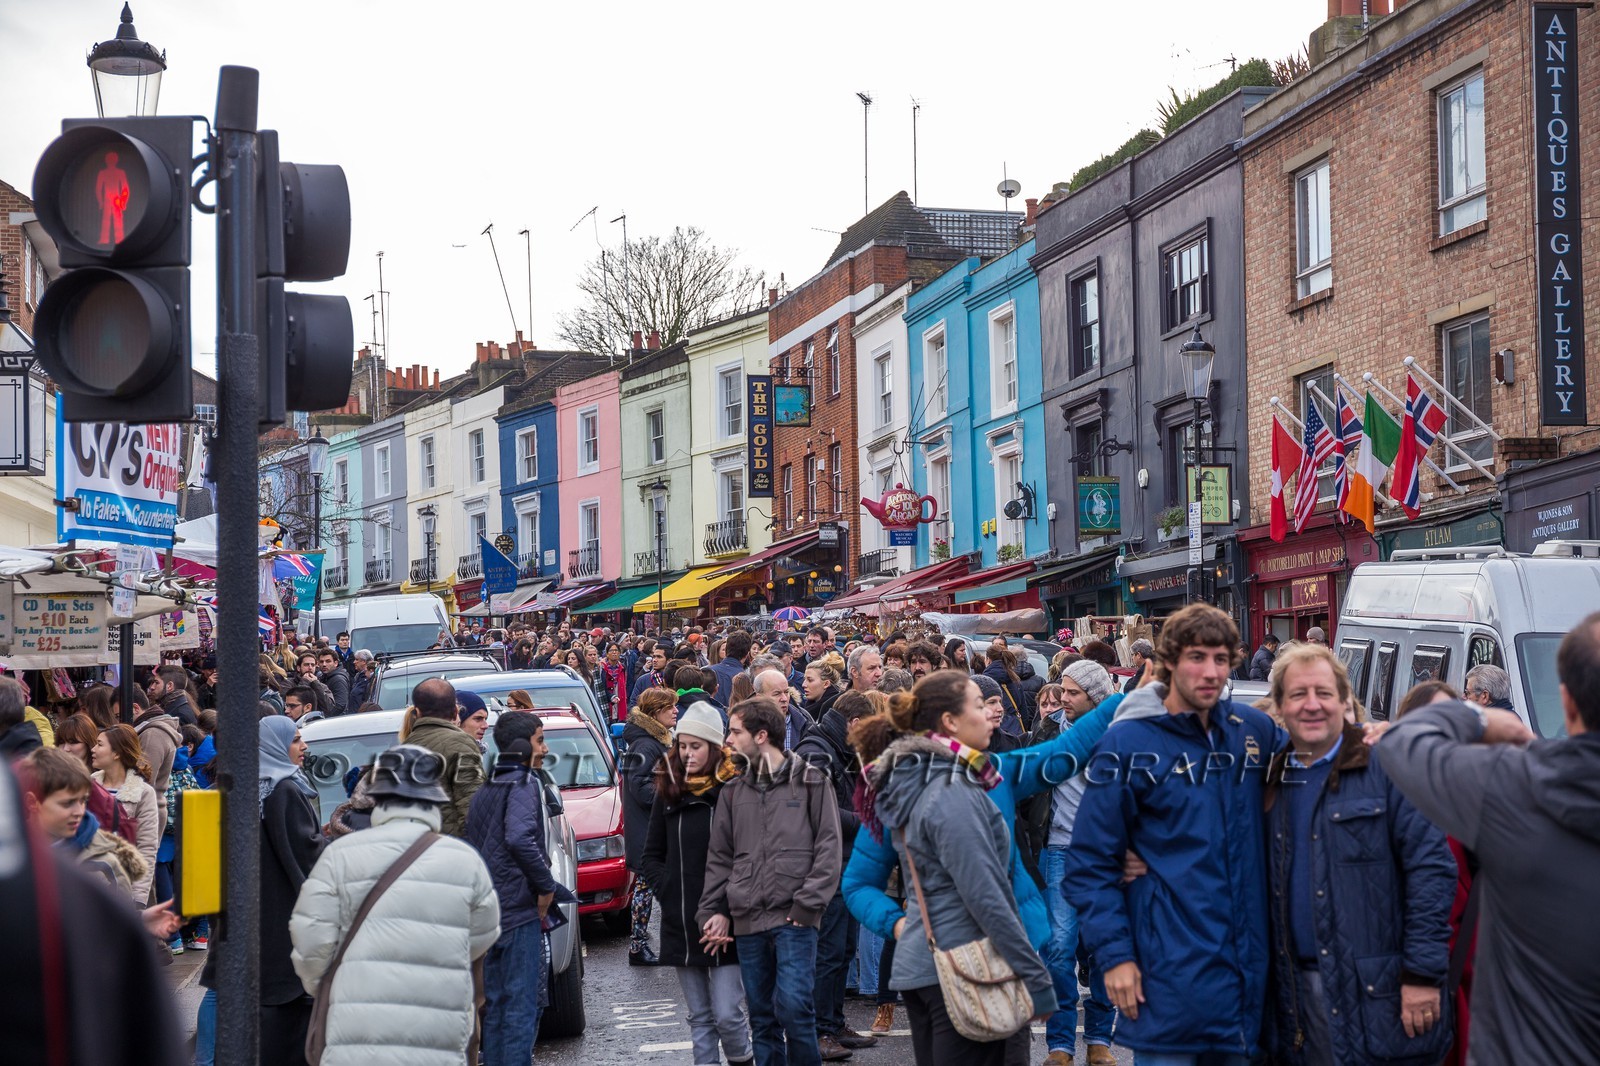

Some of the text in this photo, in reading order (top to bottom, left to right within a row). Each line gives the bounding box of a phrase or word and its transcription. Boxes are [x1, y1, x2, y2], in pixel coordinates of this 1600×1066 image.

[1546, 13, 1574, 413] ANTIQUES GALLERY
[752, 382, 767, 415] THE
[145, 424, 170, 454] NEW
[753, 424, 768, 469] GOLD
[143, 452, 178, 500] Origina
[93, 497, 120, 522] Fakes
[1424, 527, 1452, 548] ATLAM
[1531, 518, 1580, 538] ANTIQUES GALLERY
[1267, 554, 1297, 573] PORTOBELLO
[1148, 576, 1174, 591] STUMPER
[23, 599, 94, 611] CD Box Sets
[41, 612, 66, 627] £10
[69, 615, 89, 624] Each
[28, 627, 43, 636] Any
[45, 627, 67, 635] Three
[69, 627, 83, 635] Box
[22, 636, 61, 652] For £25
